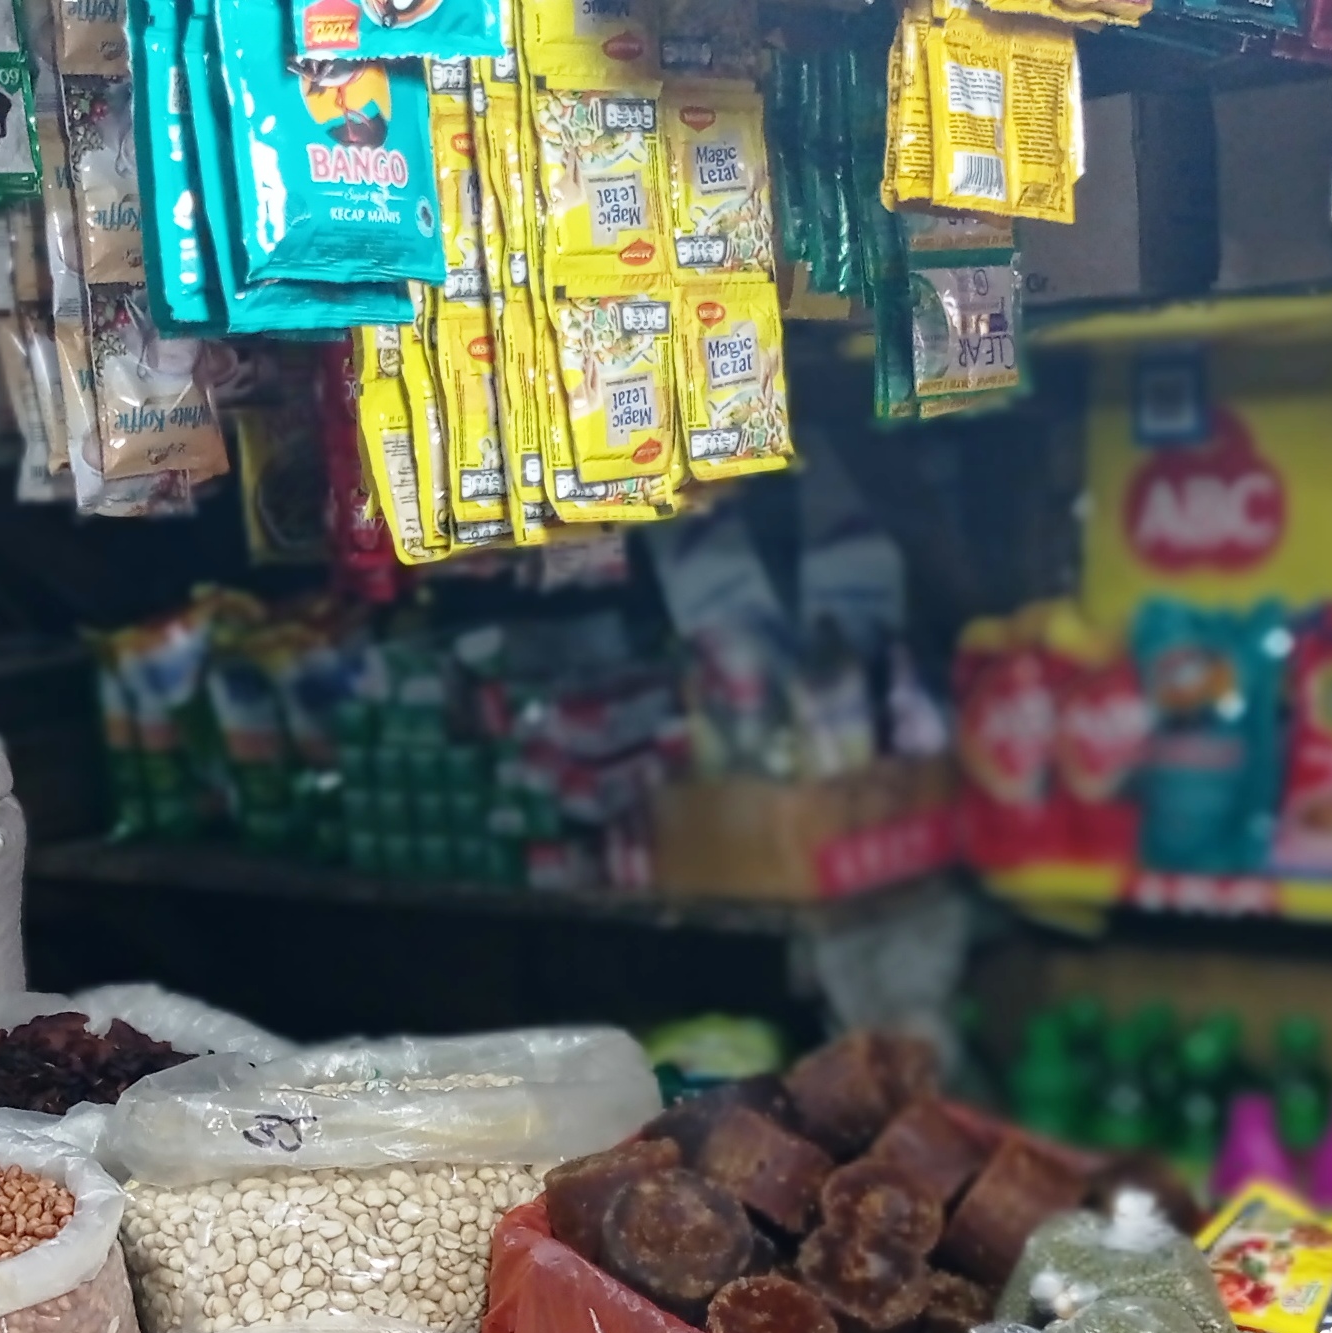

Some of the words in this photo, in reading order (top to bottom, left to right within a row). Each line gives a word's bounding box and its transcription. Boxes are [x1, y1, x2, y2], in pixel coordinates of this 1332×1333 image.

[305, 144, 409, 188] BANGO
[695, 144, 738, 167] Magic
[698, 163, 740, 186] Lezat
[596, 184, 637, 201] Lezat
[329, 207, 366, 223] KECAP
[366, 209, 402, 224] MANIS
[597, 205, 642, 232] Magic
[706, 334, 753, 360] Magic
[958, 333, 1018, 370] CLEAR
[709, 356, 754, 380] Lezat
[611, 387, 649, 408] Lezat
[113, 408, 163, 436] Koffie
[611, 407, 653, 433] Magic
[1135, 474, 1279, 547] ABC
